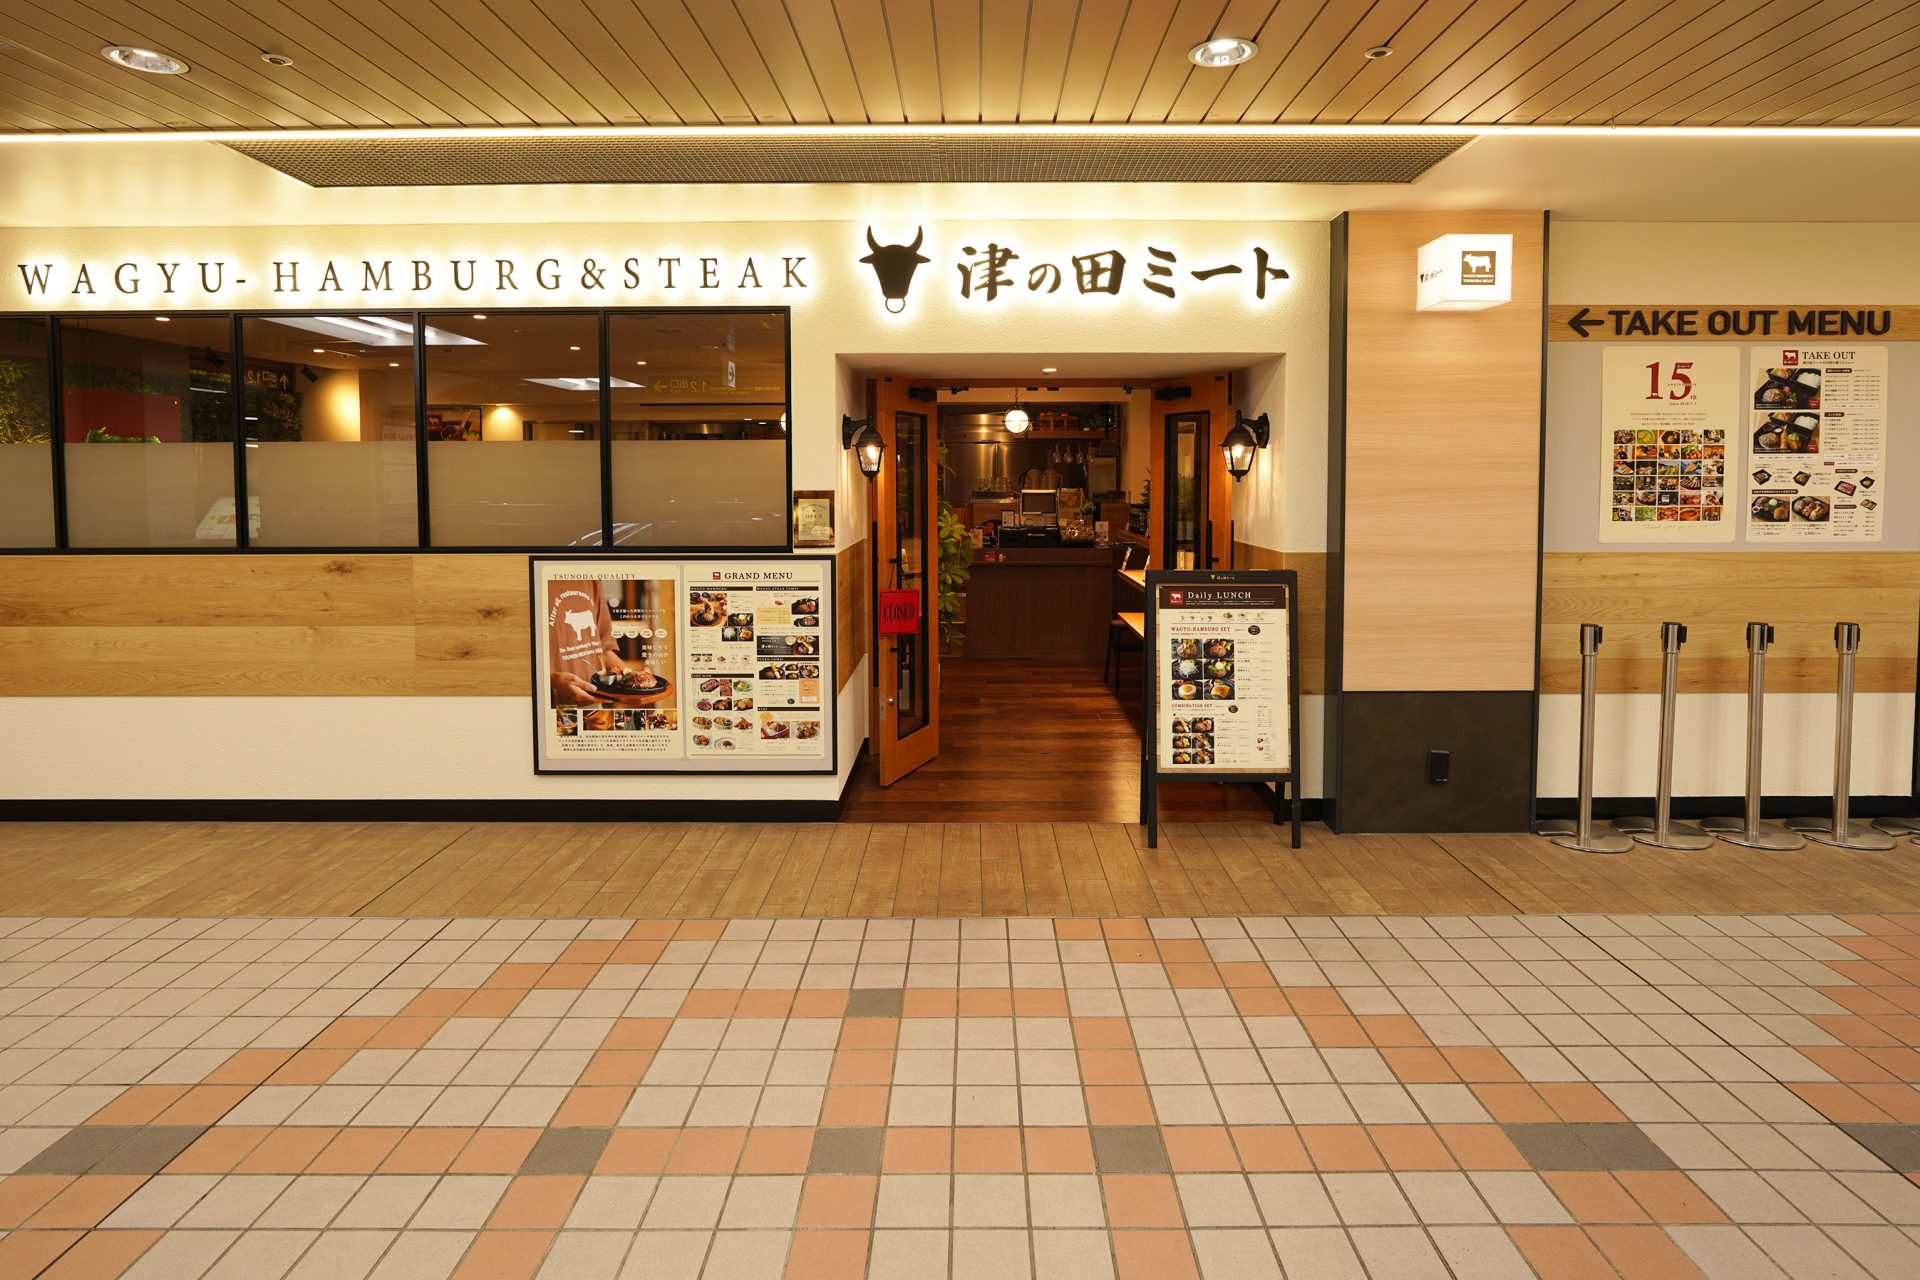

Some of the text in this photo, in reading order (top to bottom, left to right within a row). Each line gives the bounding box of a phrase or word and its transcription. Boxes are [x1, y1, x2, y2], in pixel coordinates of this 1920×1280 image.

[956, 242, 1290, 302] 津の田ミート
[1608, 310, 1892, 336] TAKE OUT MENU
[1802, 351, 1856, 360] TAKE OUT
[724, 572, 793, 580] GRAND MENU
[1187, 591, 1213, 600] Daily
[883, 603, 915, 623] CLOSED
